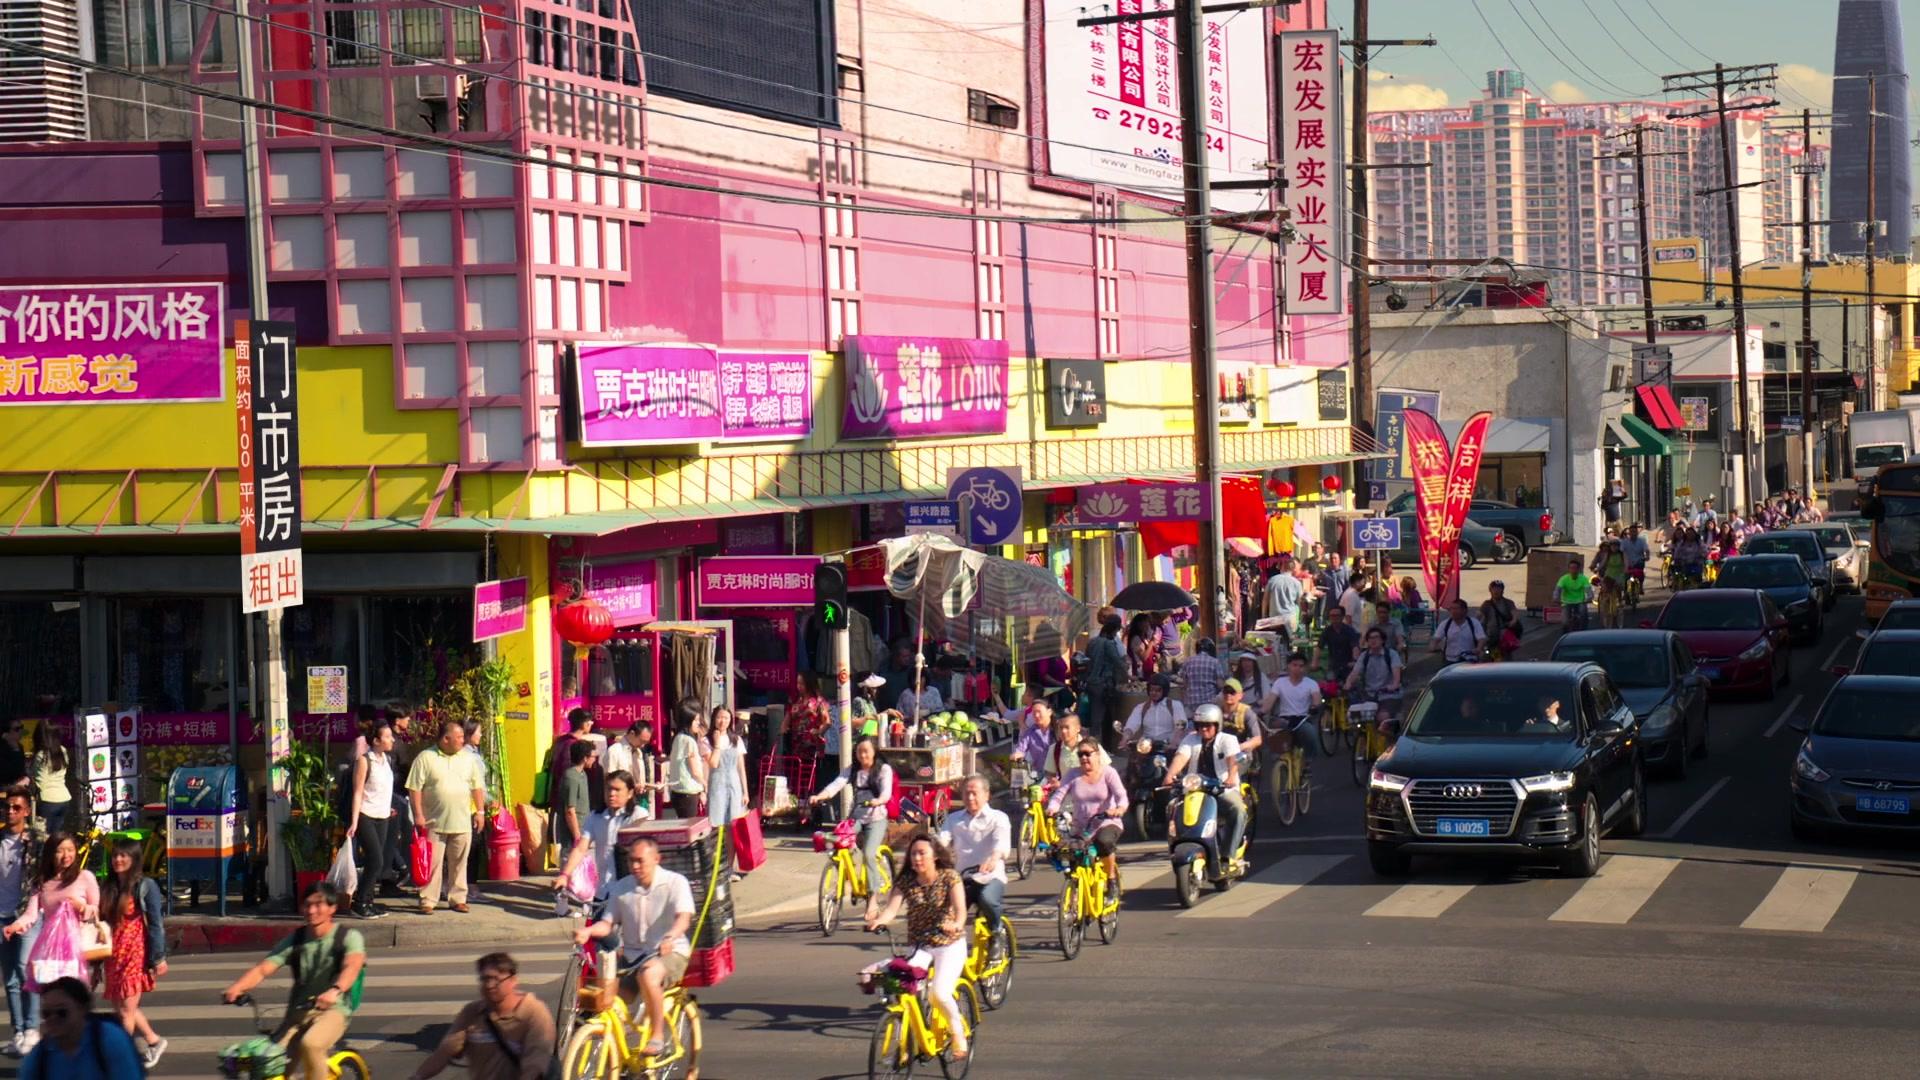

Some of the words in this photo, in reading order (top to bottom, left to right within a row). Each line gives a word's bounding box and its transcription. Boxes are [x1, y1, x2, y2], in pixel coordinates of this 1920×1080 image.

[1207, 21, 1224, 123] 宏发展广告公司
[1119, 109, 1224, 152] 2792324
[1293, 40, 1328, 301] 宏发展实业大厦
[0, 292, 210, 343] 你的风格
[0, 354, 138, 396] 新感觉
[951, 365, 1001, 412] LOTUS
[235, 340, 255, 527] 面积约100平米
[257, 331, 295, 541] 门市房
[1371, 485, 1379, 499] P
[175, 817, 213, 830] FedEx
[1454, 822, 1484, 834] 10025
